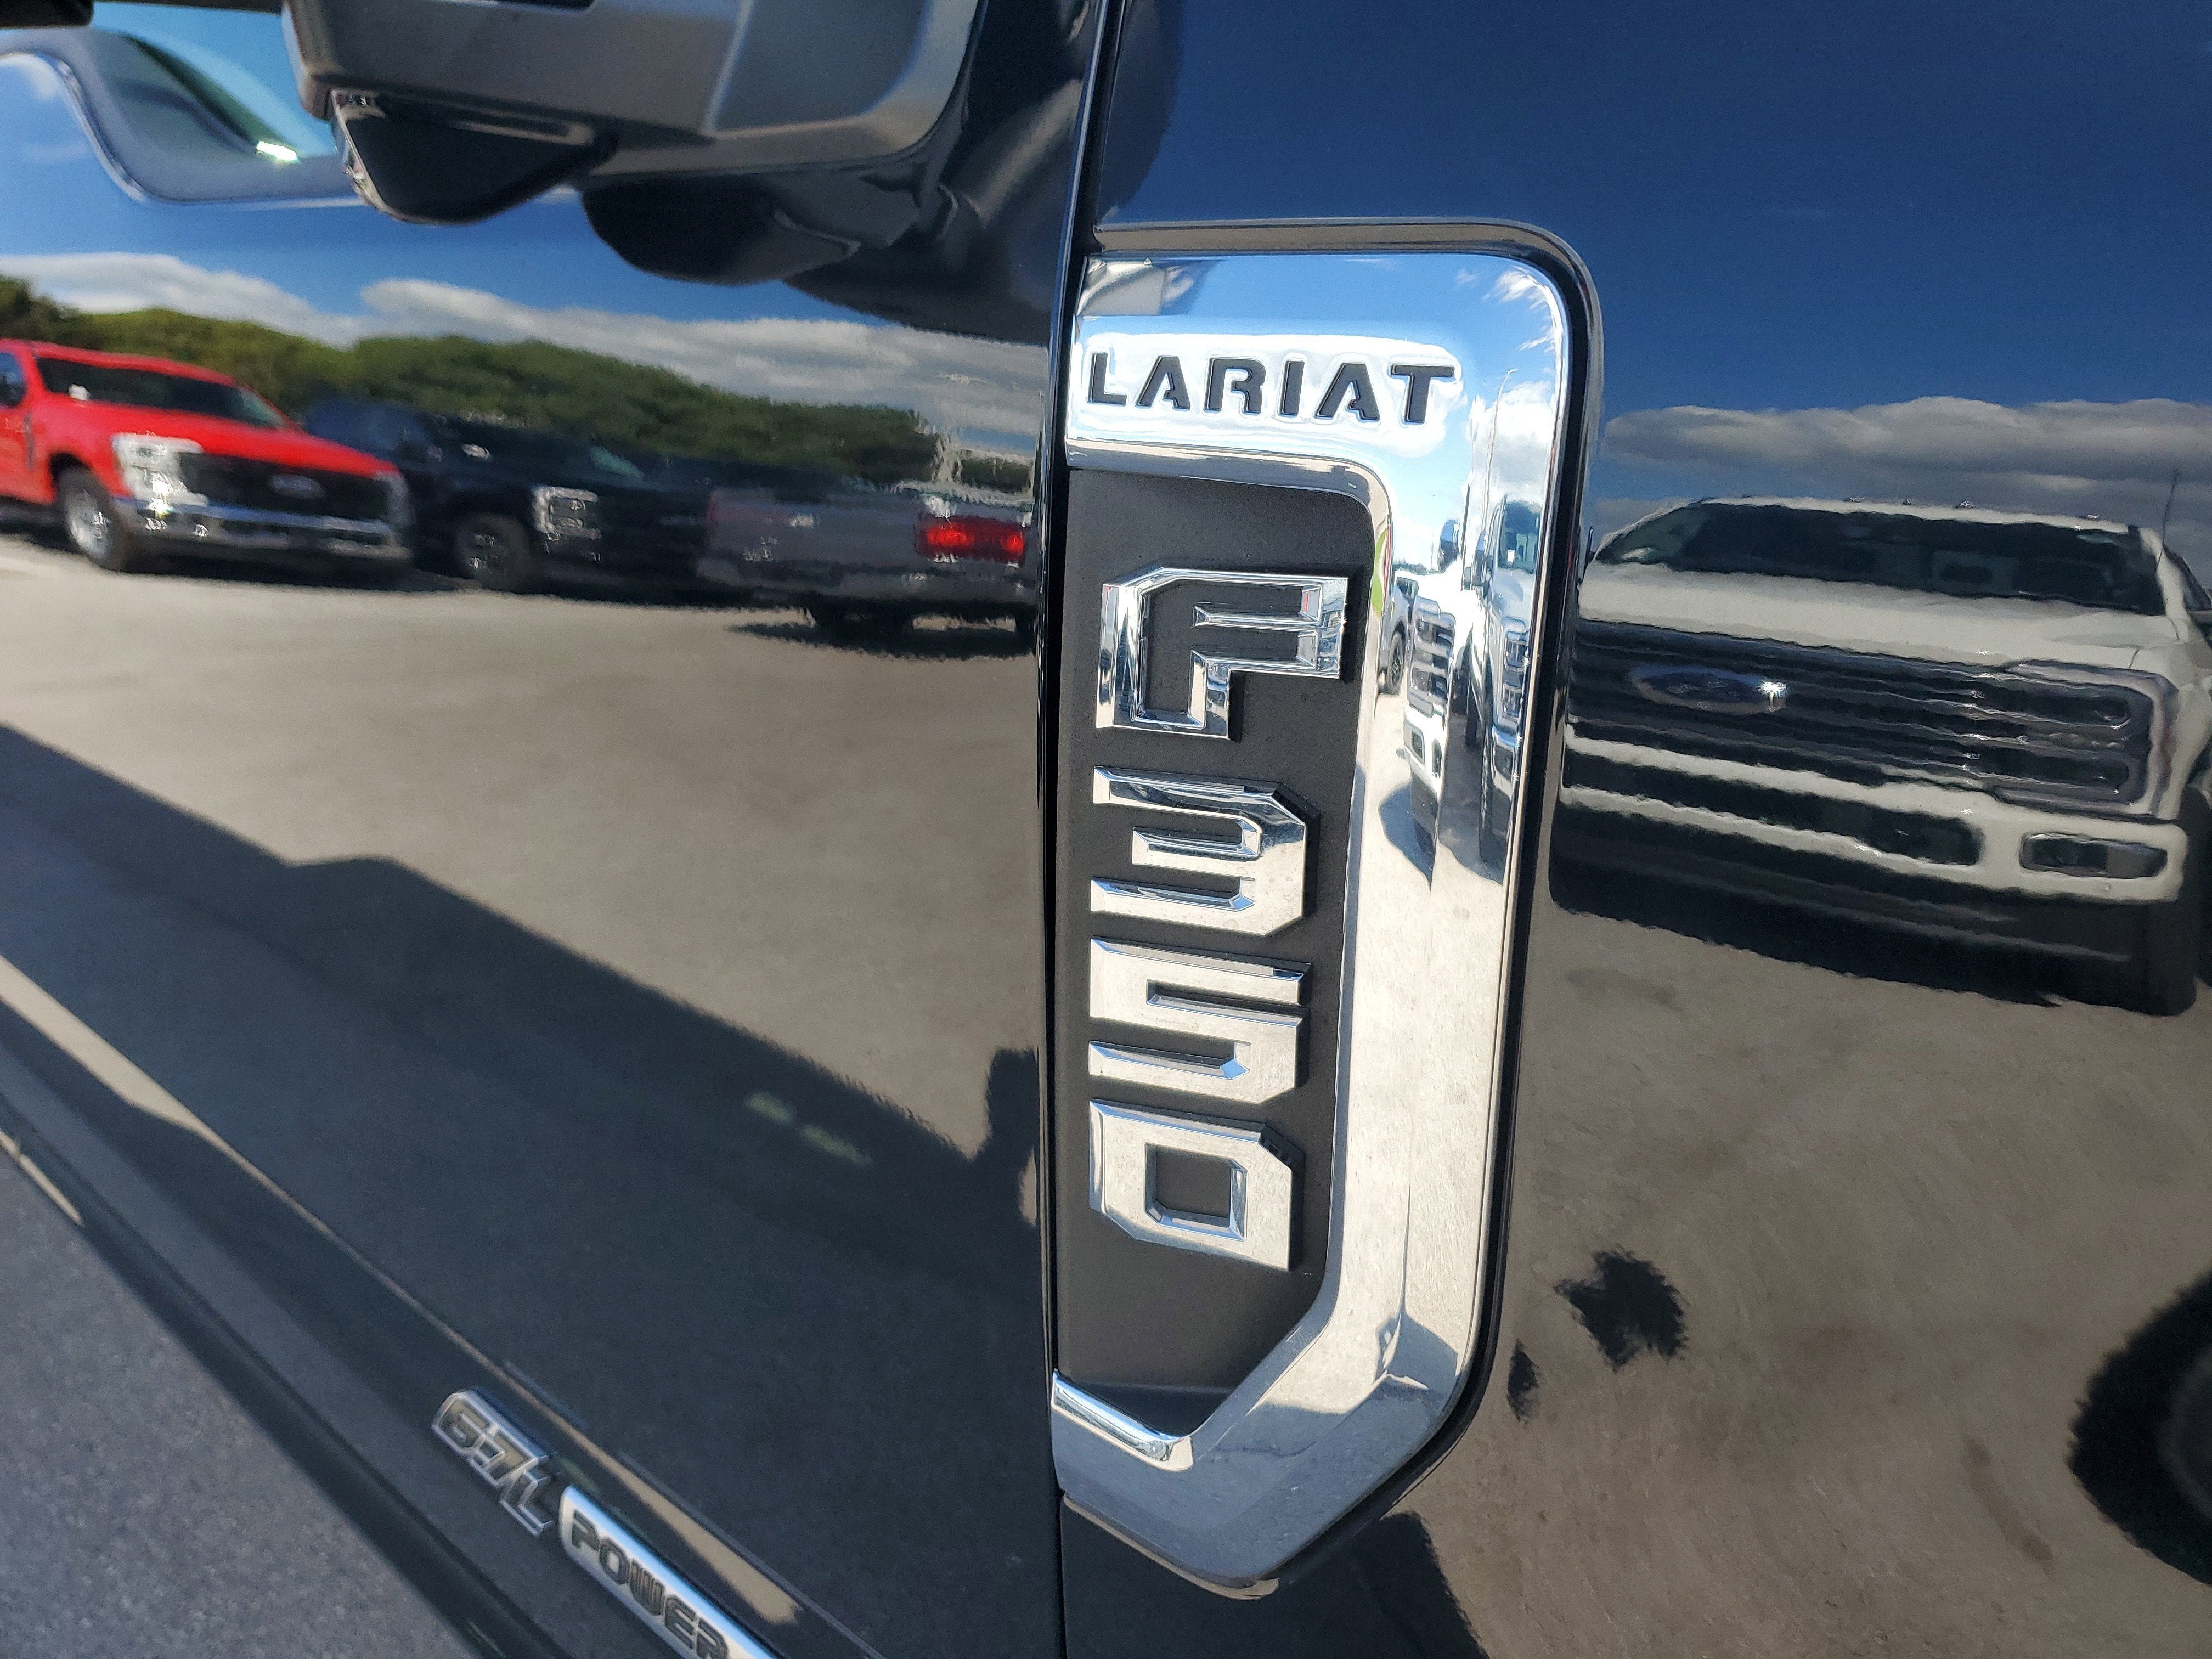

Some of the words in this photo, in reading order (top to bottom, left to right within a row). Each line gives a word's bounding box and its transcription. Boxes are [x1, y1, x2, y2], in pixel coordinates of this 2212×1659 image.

[1087, 351, 1456, 425] LARIAT
[1088, 566, 1349, 1274] F350
[571, 1508, 729, 1658] POWER
